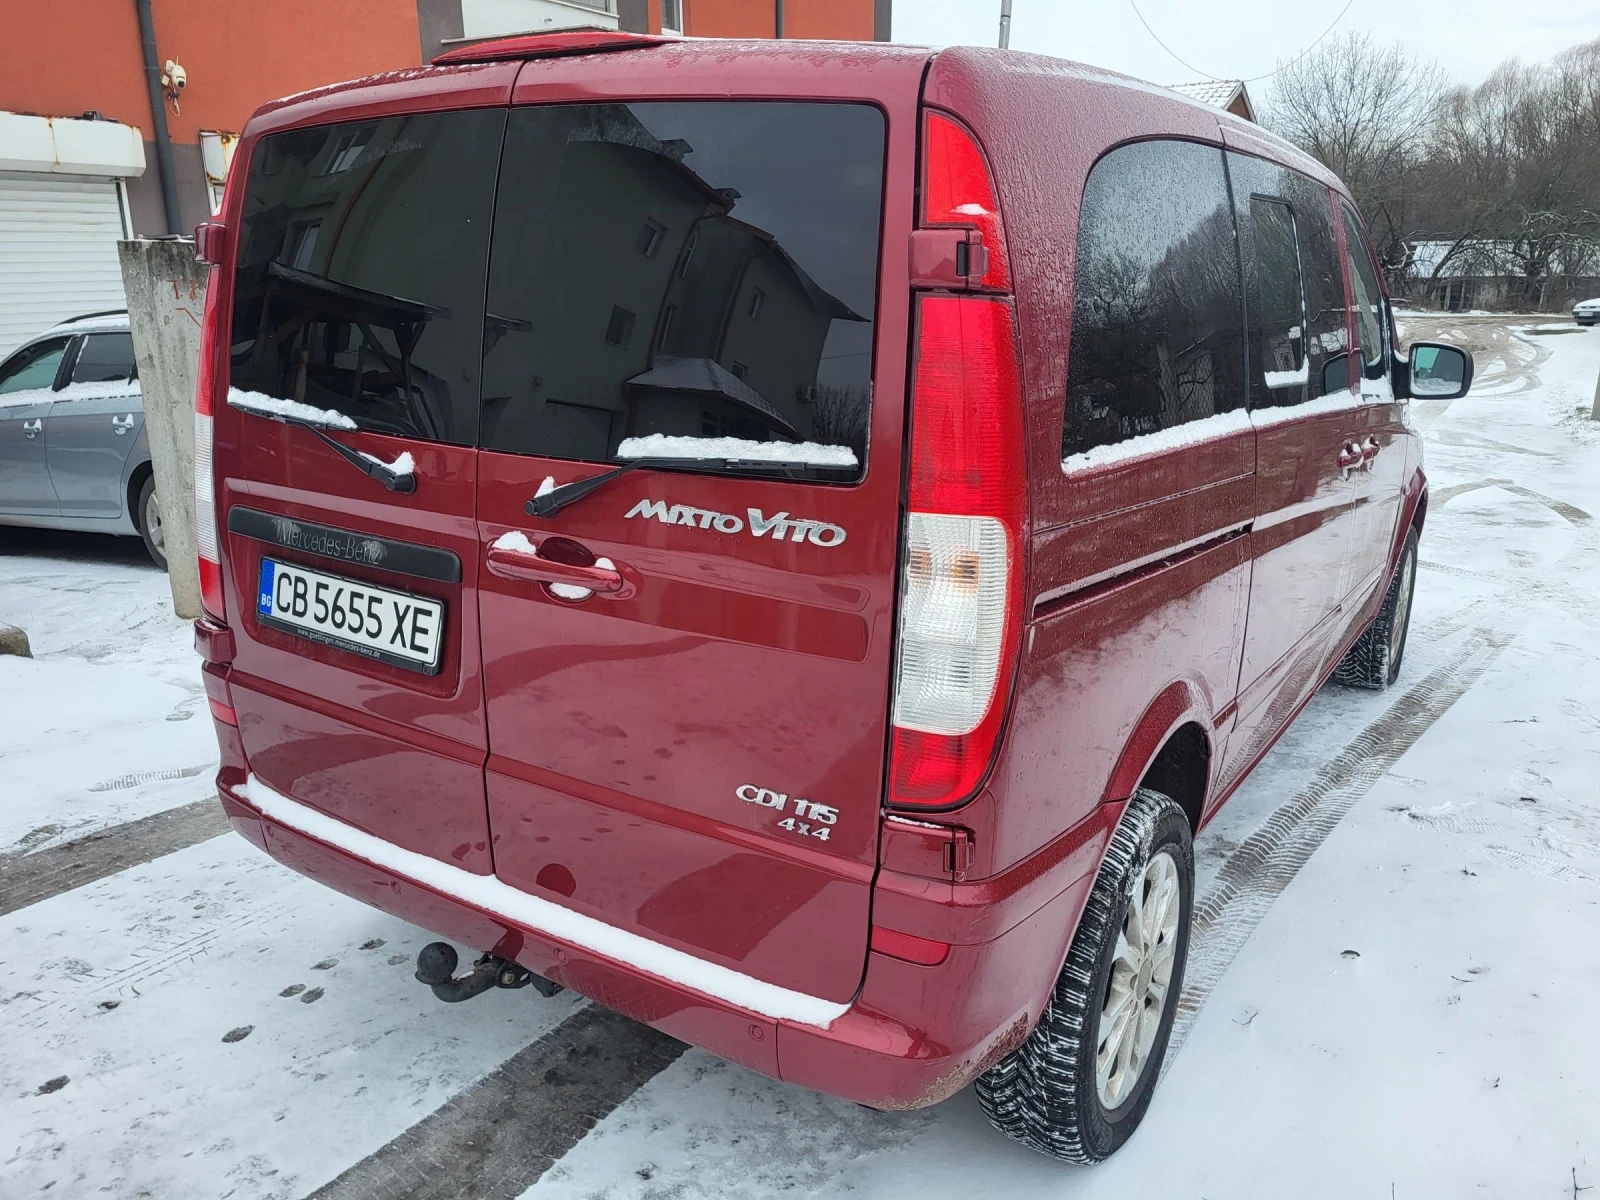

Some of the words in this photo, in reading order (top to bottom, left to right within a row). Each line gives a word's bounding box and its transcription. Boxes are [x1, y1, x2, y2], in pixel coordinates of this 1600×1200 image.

[279, 521, 382, 565] Mercedes-Benz
[624, 499, 744, 533] MIXTO
[747, 507, 847, 547] VITO
[261, 593, 272, 607] BG
[276, 572, 308, 618] CB
[314, 581, 383, 639] 5655
[390, 601, 433, 655] XE
[735, 783, 788, 811] CDI
[793, 798, 840, 825] 115
